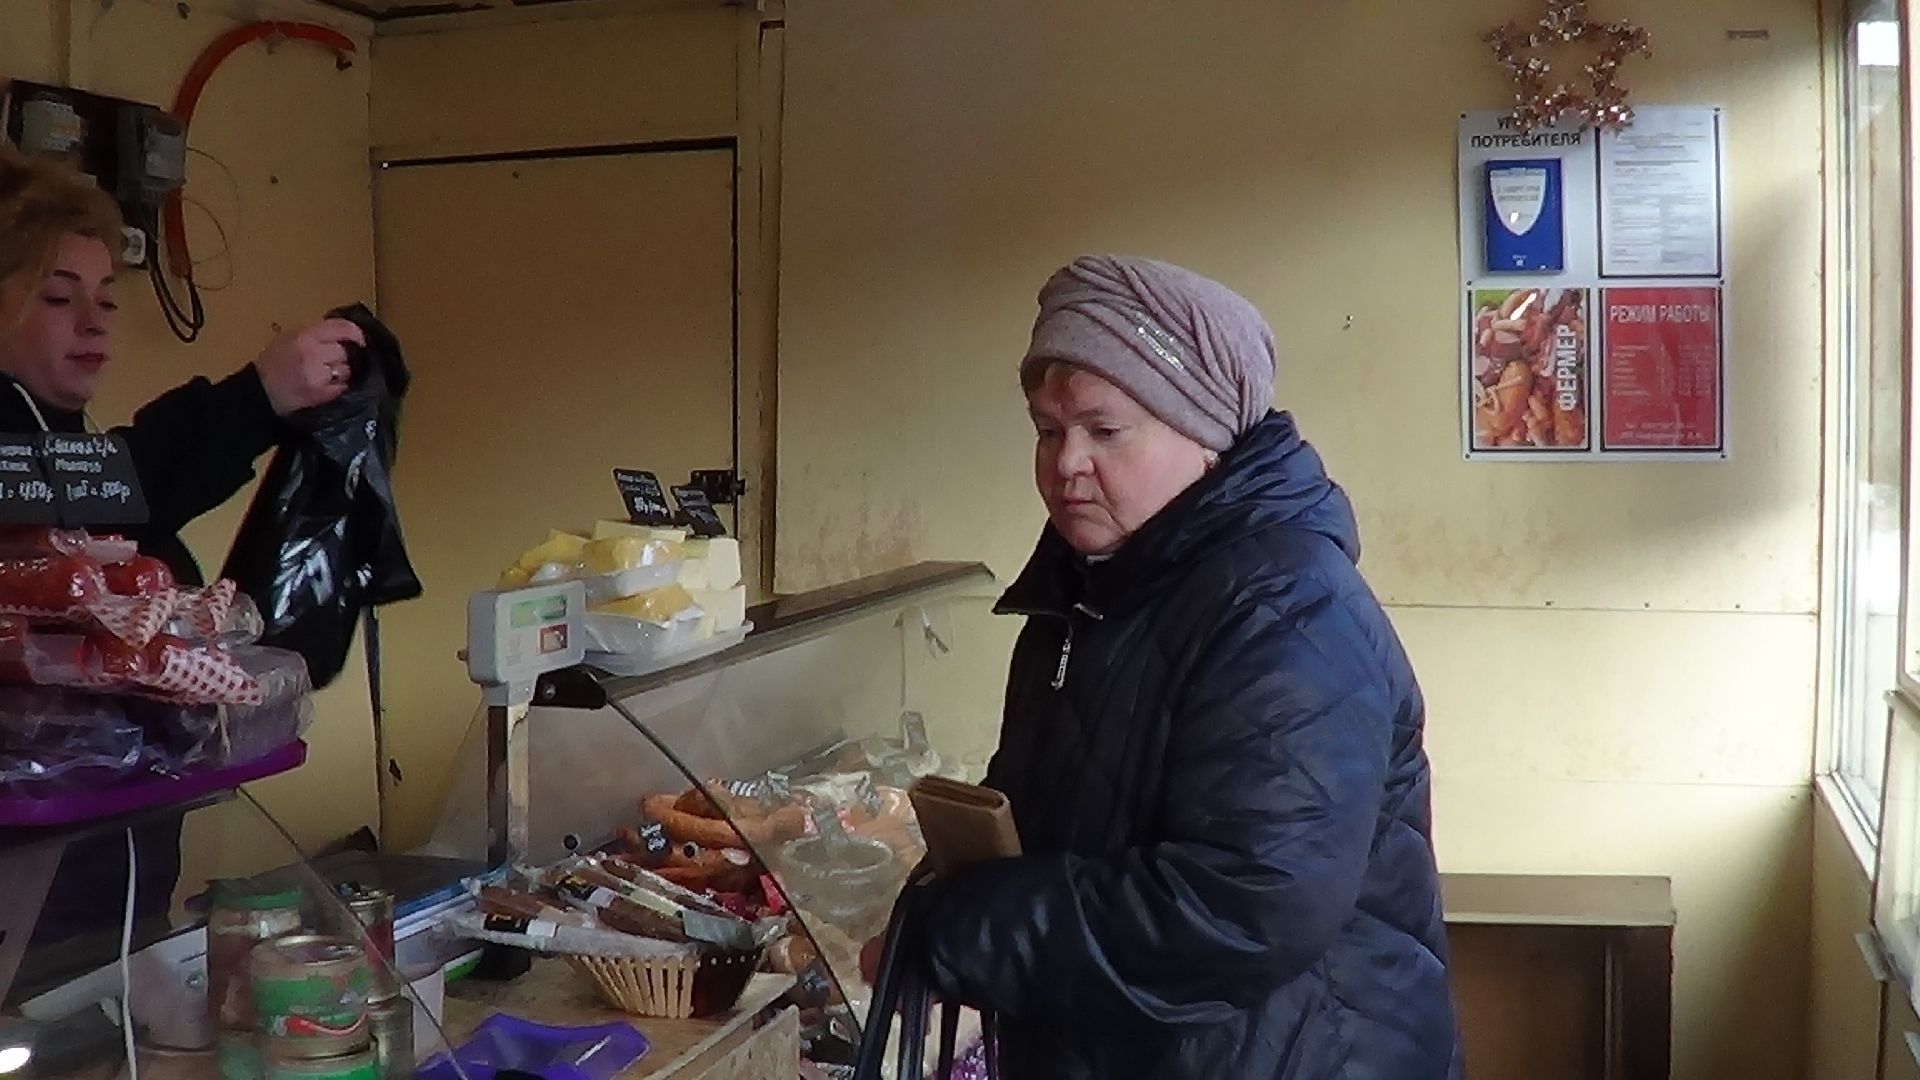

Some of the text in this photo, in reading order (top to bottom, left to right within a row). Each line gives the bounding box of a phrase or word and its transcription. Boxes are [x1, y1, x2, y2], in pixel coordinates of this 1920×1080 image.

[1471, 132, 1581, 148] ПОТРЕБИТЕЛЯ
[1610, 304, 1711, 323] РЕЖИМ РАБОТЫ
[1557, 324, 1578, 412] ФЕРМЕР
